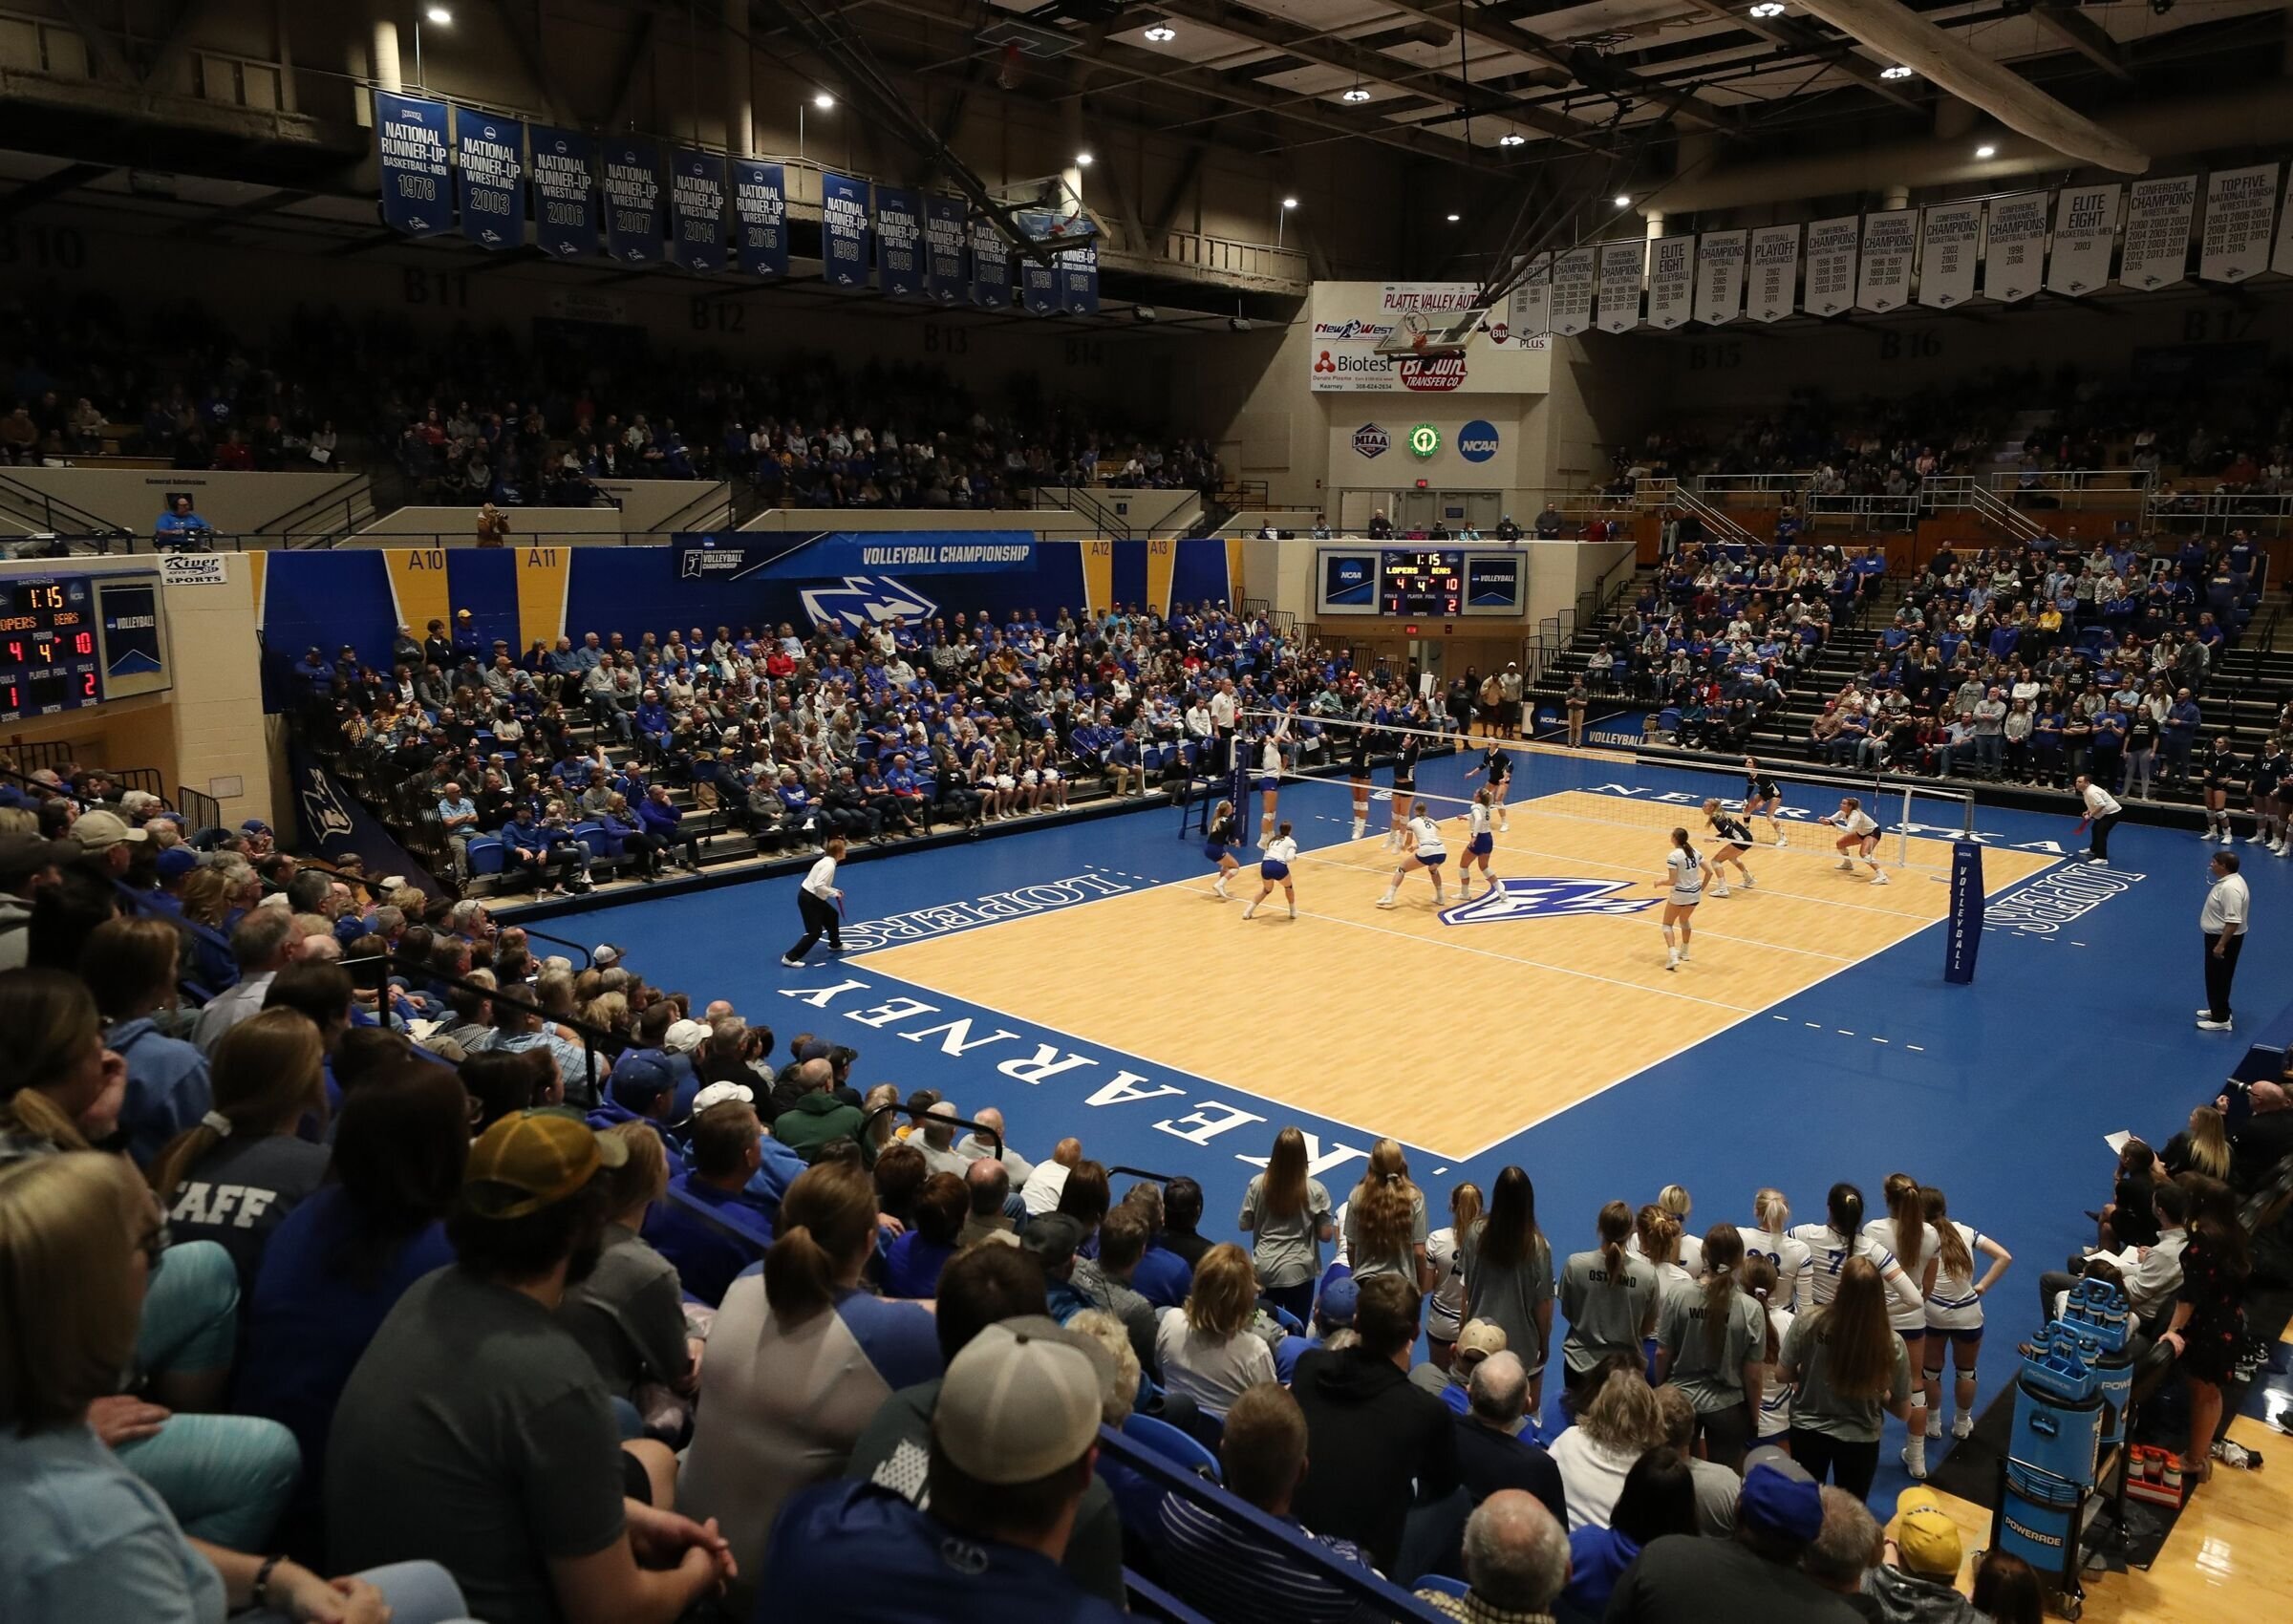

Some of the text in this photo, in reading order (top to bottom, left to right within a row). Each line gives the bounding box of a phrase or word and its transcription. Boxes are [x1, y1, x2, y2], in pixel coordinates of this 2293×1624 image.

[385, 122, 441, 147] NATIONAL
[382, 138, 447, 162] RUNNER-UP
[464, 138, 516, 163] NATIONAL
[460, 153, 520, 180] RUNNER-UP
[537, 154, 587, 176] NATIONAL
[466, 170, 514, 190] WRESTLING
[534, 168, 591, 189] RUNNER-UP
[608, 164, 654, 184] NATIONAL
[397, 174, 436, 201] 1978
[606, 179, 657, 199] RUNNER-UP
[676, 176, 720, 195] NATIONAL
[2137, 182, 2188, 196] CONFERENCE
[2221, 175, 2266, 191] TOP FIVE
[542, 184, 587, 201] WRESTLING
[674, 189, 724, 210] RUNNER-UP
[739, 183, 780, 201] NATIONAL
[2209, 190, 2245, 203] NATIONAL
[2249, 187, 2275, 199] FINISH
[471, 188, 510, 216] 2003
[612, 195, 654, 210] WRESTLING
[736, 198, 783, 216] RUNNER-UP
[827, 197, 864, 217] NATIONAL
[2000, 203, 2037, 214] CONFERENCE
[2073, 194, 2105, 212] ELITE
[2131, 192, 2194, 210] CHAMPIONS
[2219, 199, 2262, 211] WRESTLING
[547, 203, 585, 226] 2006
[679, 204, 718, 221] WRESTLING
[742, 212, 780, 225] WRESTLING
[881, 210, 916, 227] NATIONAL
[1936, 212, 1971, 222] CONFERENCE
[1997, 210, 2040, 223] TOURNAMENT
[2068, 211, 2105, 229] EIGHT
[2142, 206, 2179, 218] WRESTLING
[2251, 208, 2272, 219] 2007
[617, 210, 651, 233] 2007
[824, 210, 868, 231] RUNNER-UP
[930, 218, 963, 235] NATIONAL
[1874, 219, 1909, 229] CONFERENCE
[1926, 220, 1978, 236] CHAMPIONS
[1989, 218, 2045, 236] CHAMPIONS
[684, 221, 715, 244] 2014
[749, 227, 778, 248] 2015
[831, 225, 860, 239] SOFTBALL
[878, 223, 919, 241] RUNNER-UP
[1817, 225, 1850, 235] CONFERENCE
[1871, 226, 1909, 236] TOURNAMENT
[2207, 230, 2268, 246] 2011 2013
[885, 237, 913, 250] SOFTBALL
[928, 230, 965, 248] RUNNER-UP
[1762, 234, 1789, 243] FOOTBALL
[1810, 232, 1856, 248] CHAMPIONS
[1865, 235, 1913, 249] CHAMPIONS
[933, 245, 959, 256] SOFTBALL
[1062, 250, 1096, 264] RUNNER-UP
[1609, 250, 1636, 259] CONFERENCE
[1661, 244, 1683, 258] ELITE
[1701, 246, 1745, 260] CHAMPIONS
[1755, 241, 1796, 258] PLAYOFF
[2205, 245, 2245, 256] 2014 2015
[1555, 262, 1593, 275] CHAMPIONS
[1659, 258, 1685, 273] EIGHT
[1708, 258, 1734, 267] FOOTBALL
[1755, 255, 1793, 266] APPEARANCES
[1601, 265, 1641, 277] CHAMPIONS
[1653, 271, 1689, 283] VOLLEYBALL
[1607, 276, 1634, 285] VOLLEYBALL
[1384, 294, 1454, 310] PLATTE VALLEY
[1338, 355, 1393, 372] Biotest
[1406, 376, 1460, 387] TRANSFER CO.
[1355, 436, 1387, 445] MIAA
[1462, 440, 1497, 452] NCAA
[864, 545, 1030, 565] VOLLEYBALL CHAMPIONSHIP
[1091, 542, 1108, 556] A12
[1150, 541, 1168, 554] A13
[164, 556, 219, 571] River
[409, 550, 443, 570] A10
[527, 548, 556, 567] A11
[703, 554, 742, 564] VOLLEYBALL
[1417, 554, 1441, 566] 1:15
[1397, 578, 1458, 592] 4 4 10
[1481, 573, 1513, 582] VOLLEYBALL
[31, 586, 63, 609] 1:15
[1393, 600, 1456, 611] 1 2
[54, 612, 79, 627] BEARS
[117, 615, 155, 630] VOLLEYBALL
[32, 630, 54, 640] PERIOD
[9, 631, 92, 663] 4 4 10
[29, 670, 50, 680] PLAYER
[77, 663, 94, 673] FOULS
[10, 673, 96, 708] 1 2
[1589, 730, 1643, 747] VOLLEYBALL
[2261, 762, 2271, 771] 12
[1684, 856, 1697, 869] 18
[1983, 863, 2147, 933] LOPERS
[818, 874, 1131, 951] LOPERS
[1955, 865, 1967, 970] VOLLEYBALL
[170, 1181, 277, 1229] AFF
[1829, 1250, 1846, 1275] 7
[2004, 1516, 2062, 1548] POWERADE
